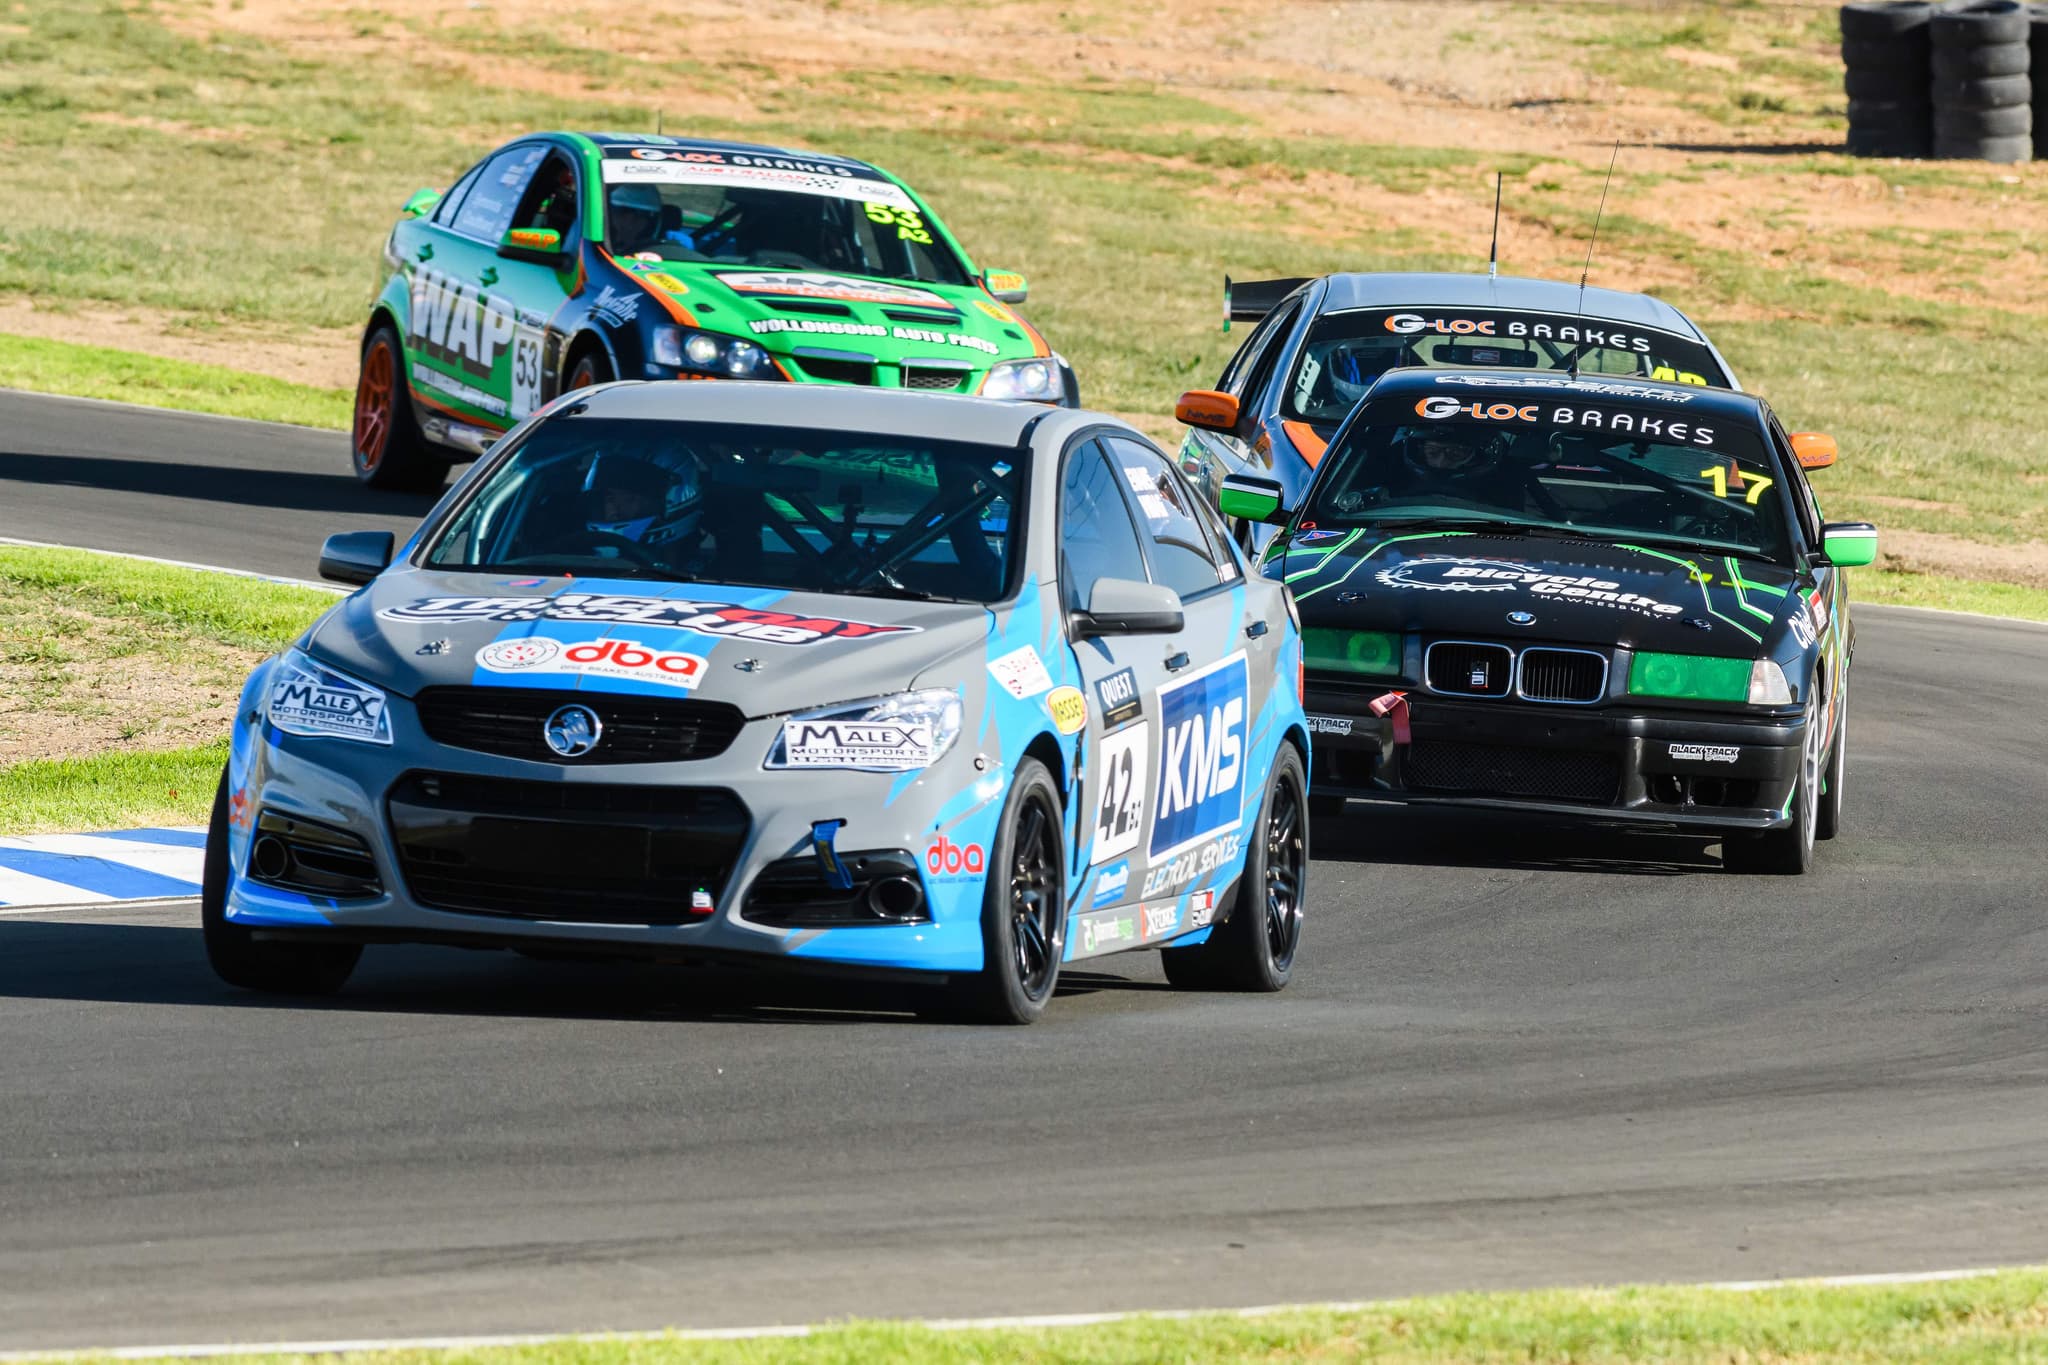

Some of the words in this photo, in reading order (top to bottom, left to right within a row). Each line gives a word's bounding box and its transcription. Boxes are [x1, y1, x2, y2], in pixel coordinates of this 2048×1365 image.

[732, 155, 853, 176] BRAKES
[864, 201, 923, 229] 53
[511, 231, 557, 248] WAP
[898, 226, 933, 244] A2
[411, 261, 516, 369] WAP
[1384, 313, 1496, 335] G-LOC
[1508, 321, 1651, 352] BRAKES
[750, 319, 888, 337] WOLLONGONG
[893, 326, 946, 344] AUTO
[949, 334, 1000, 356] PARTS
[515, 339, 541, 390] 53
[1415, 396, 1539, 422] G-LOC
[1553, 407, 1714, 446] BRAKES
[1701, 465, 1773, 505] 17
[1530, 582, 1684, 615] Centre
[565, 641, 699, 676] dba
[1100, 671, 1134, 709] QUEST
[271, 704, 374, 728] MOTORSPORTS
[791, 747, 929, 757] MOTORSPORTS
[1159, 696, 1243, 820] KMS
[1669, 744, 1703, 754] BLACK
[1705, 747, 1739, 756] TRACK
[1099, 746, 1133, 842] 42
[927, 835, 984, 875] dba
